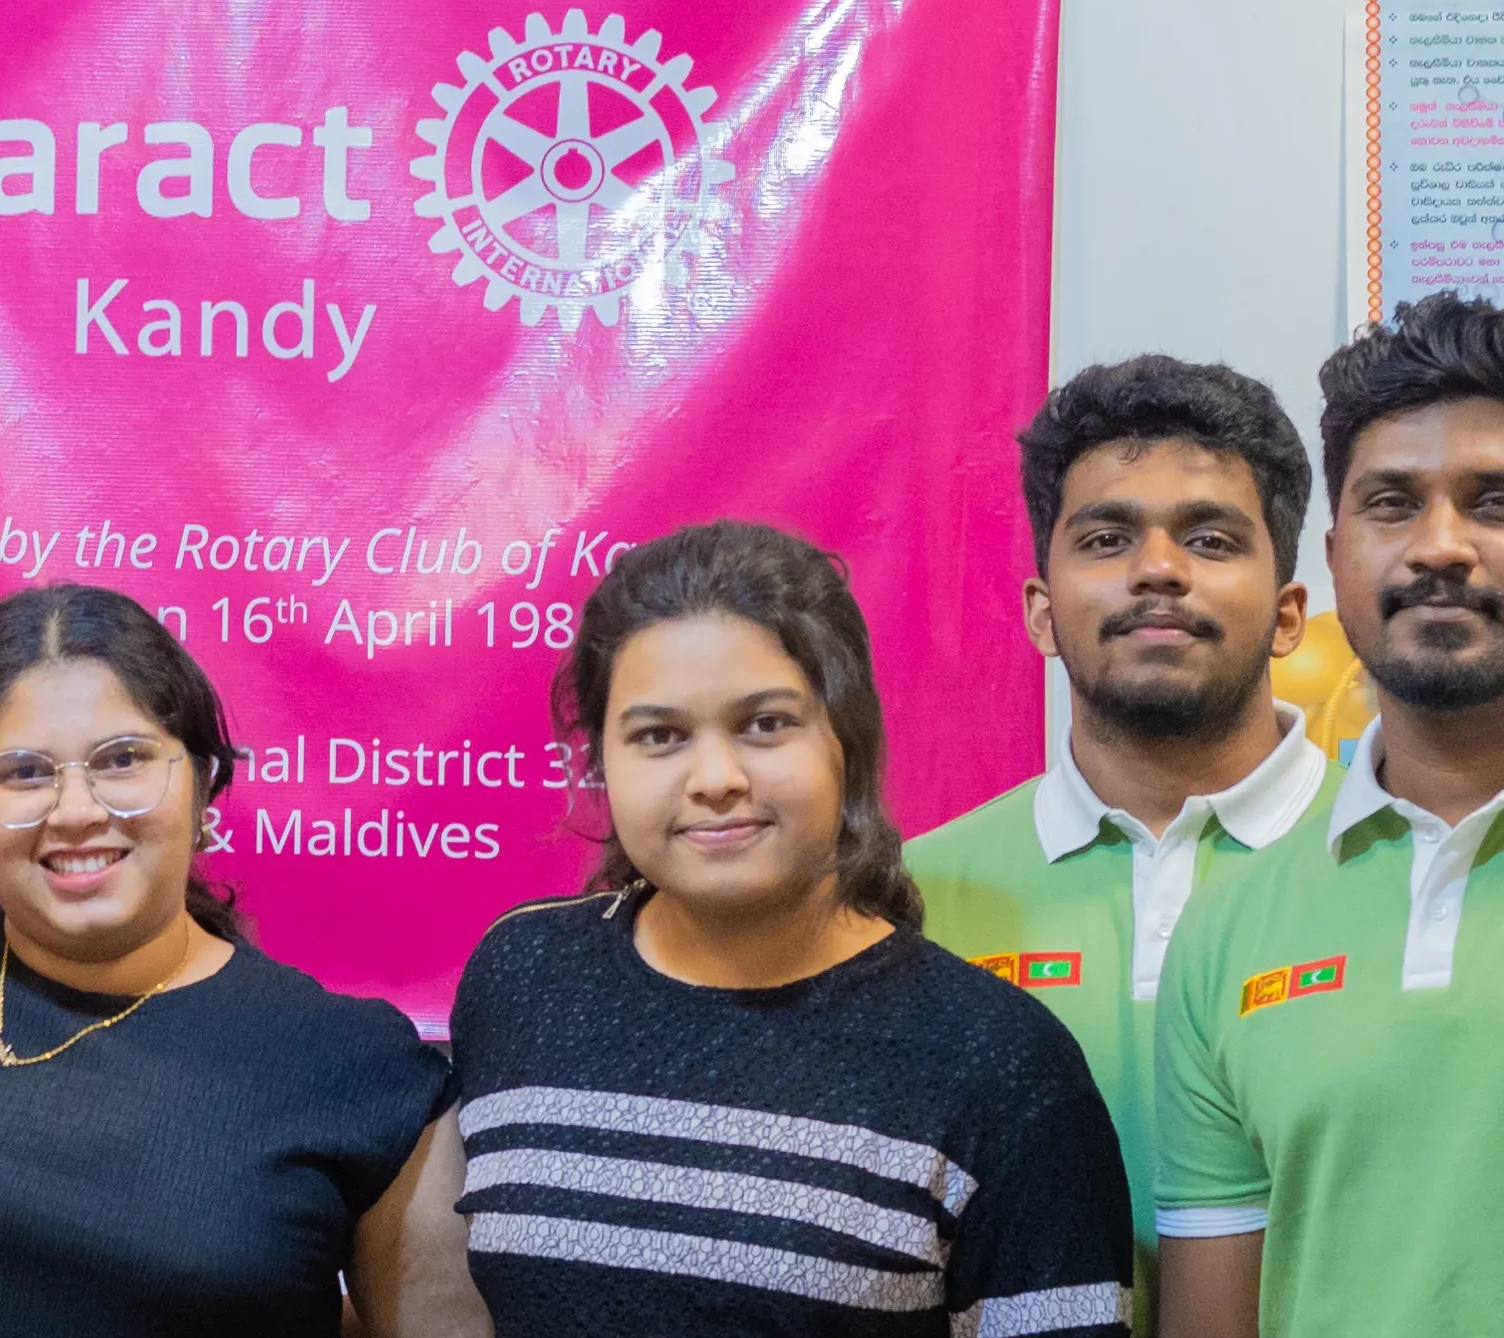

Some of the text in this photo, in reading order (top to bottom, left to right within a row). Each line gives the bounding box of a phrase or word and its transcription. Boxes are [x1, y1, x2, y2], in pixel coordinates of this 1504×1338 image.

[507, 44, 643, 83] ROTARY
[74, 277, 378, 383] Kandy
[75, 519, 157, 569] the
[175, 523, 352, 587] Rotary
[366, 526, 482, 576] Club
[501, 526, 563, 590] of
[211, 594, 308, 644] 16th
[324, 598, 453, 659] April
[477, 600, 575, 649] 198
[328, 738, 525, 789] District
[255, 808, 501, 860] Maldives
